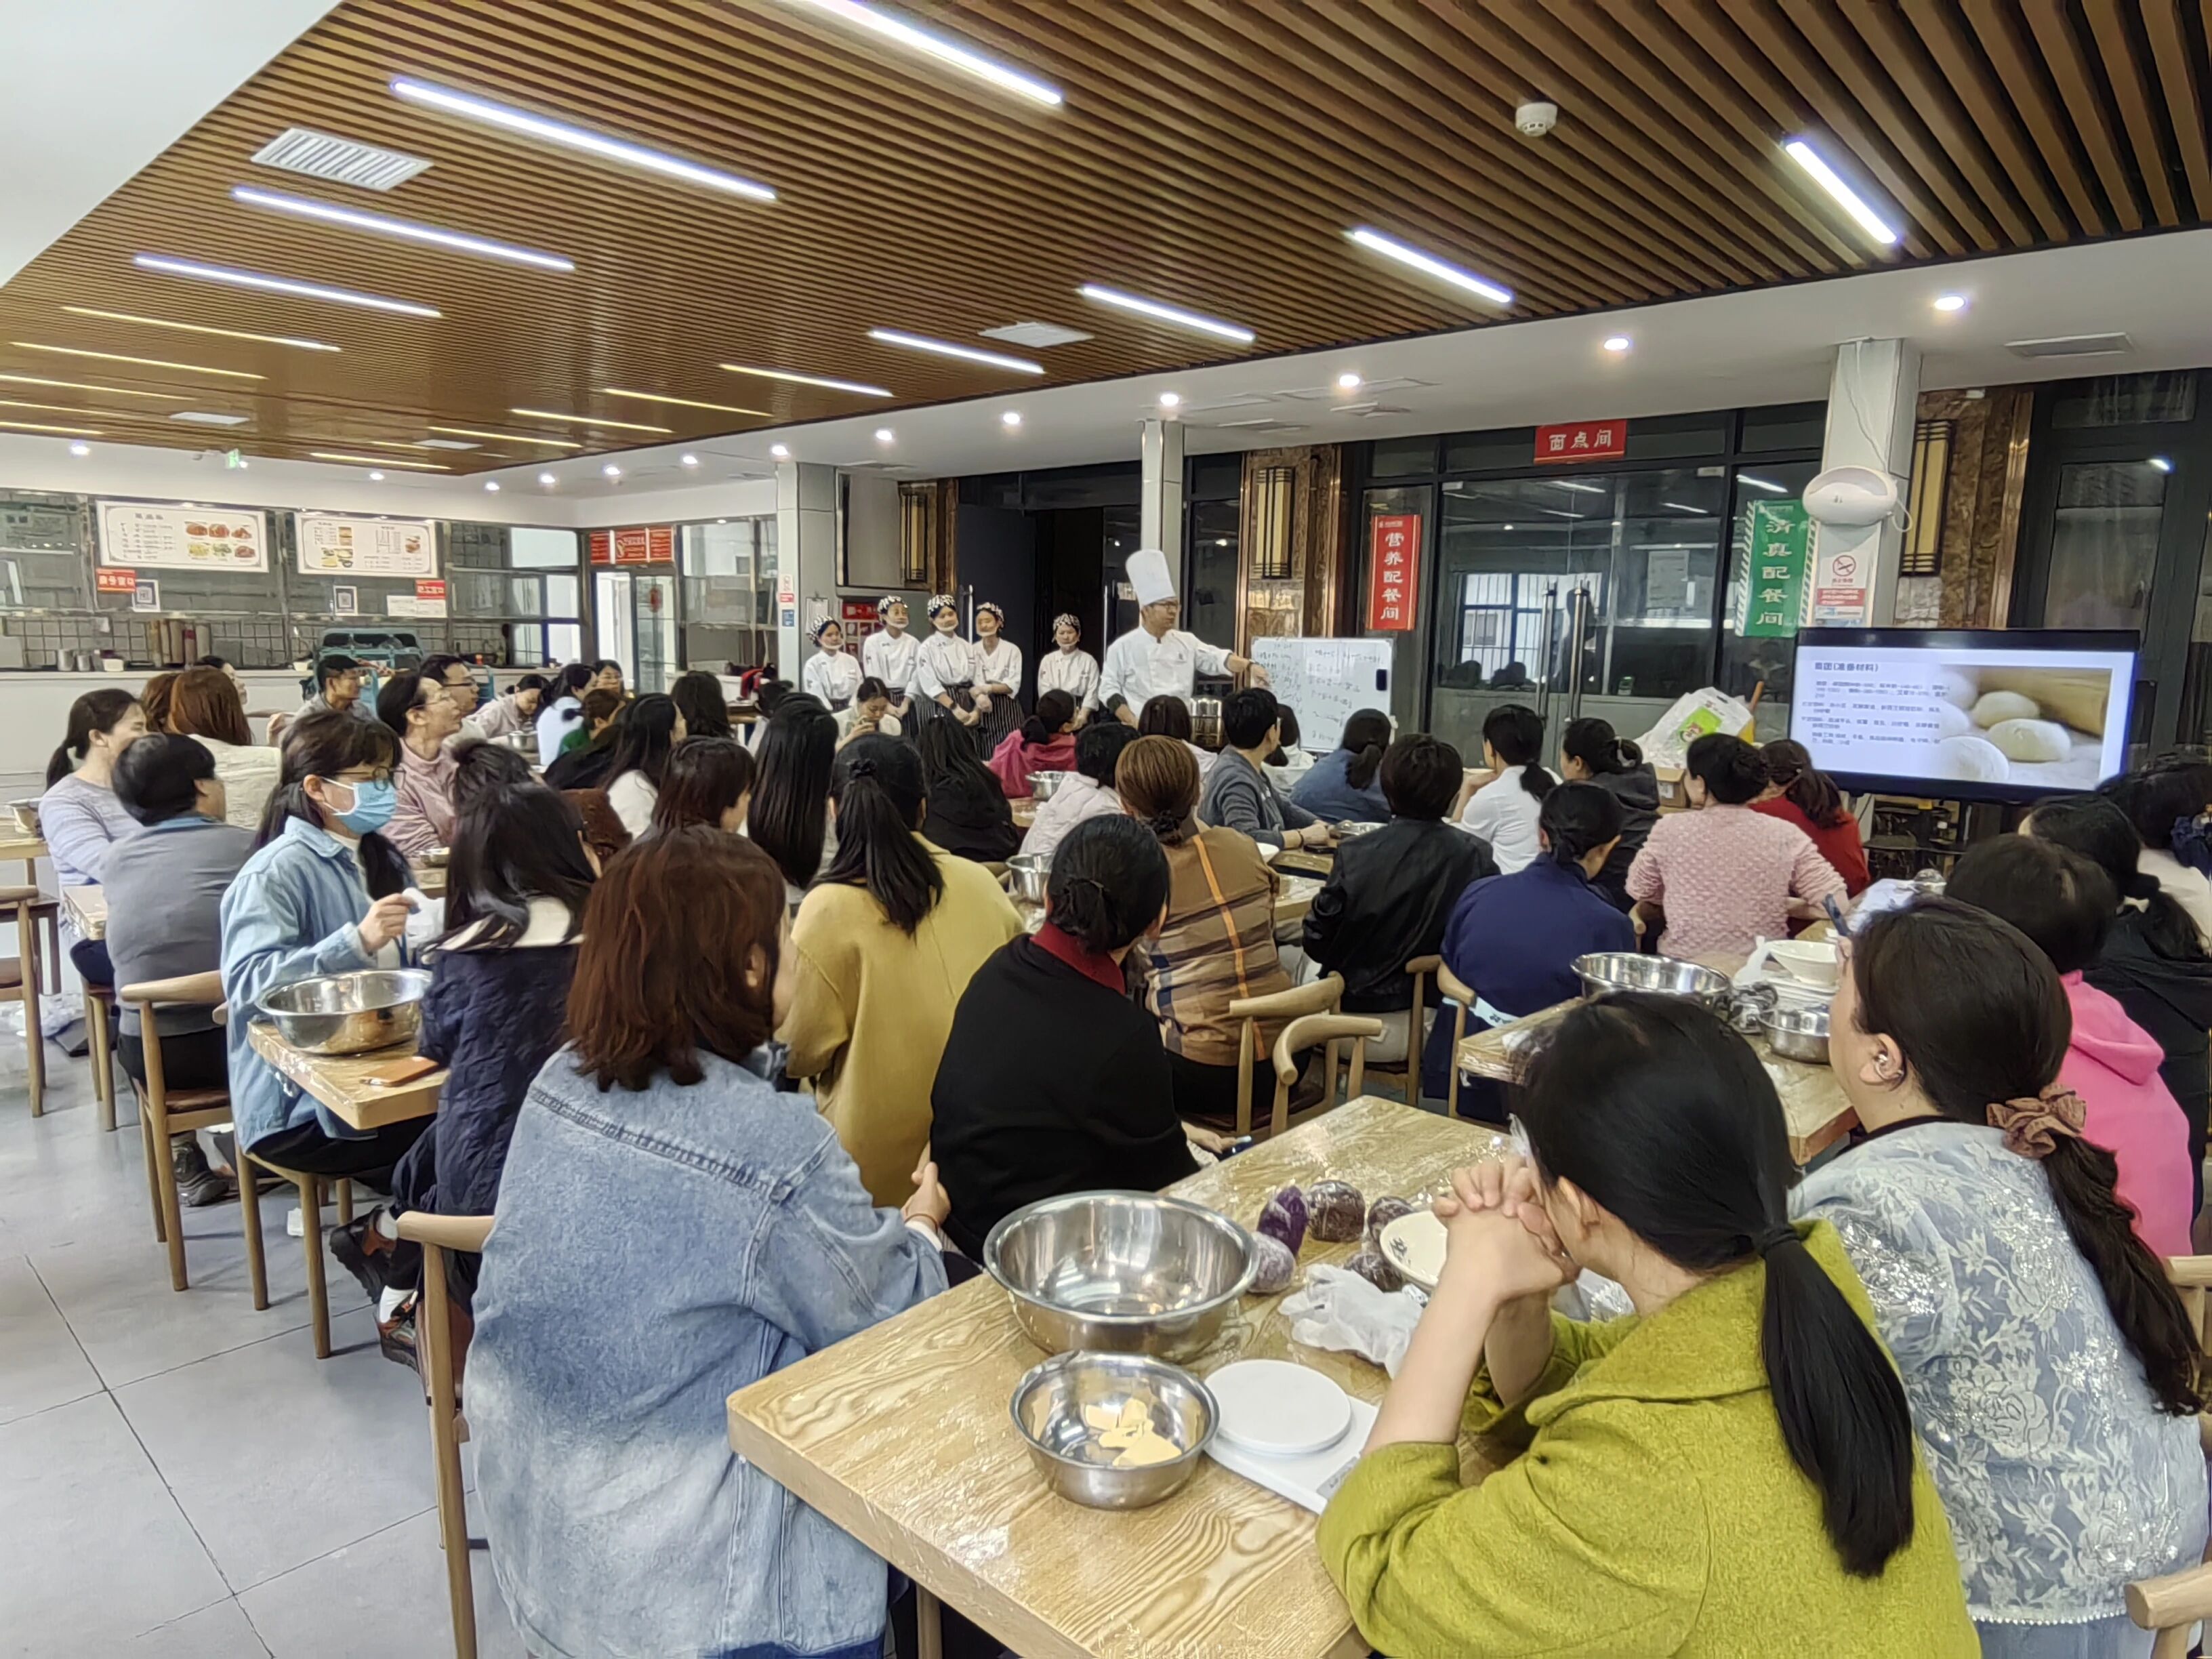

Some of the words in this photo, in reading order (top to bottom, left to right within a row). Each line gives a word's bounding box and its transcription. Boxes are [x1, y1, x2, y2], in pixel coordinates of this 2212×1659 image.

[1549, 430, 1612, 451] 面点间
[1380, 532, 1404, 620] 营养配餐间
